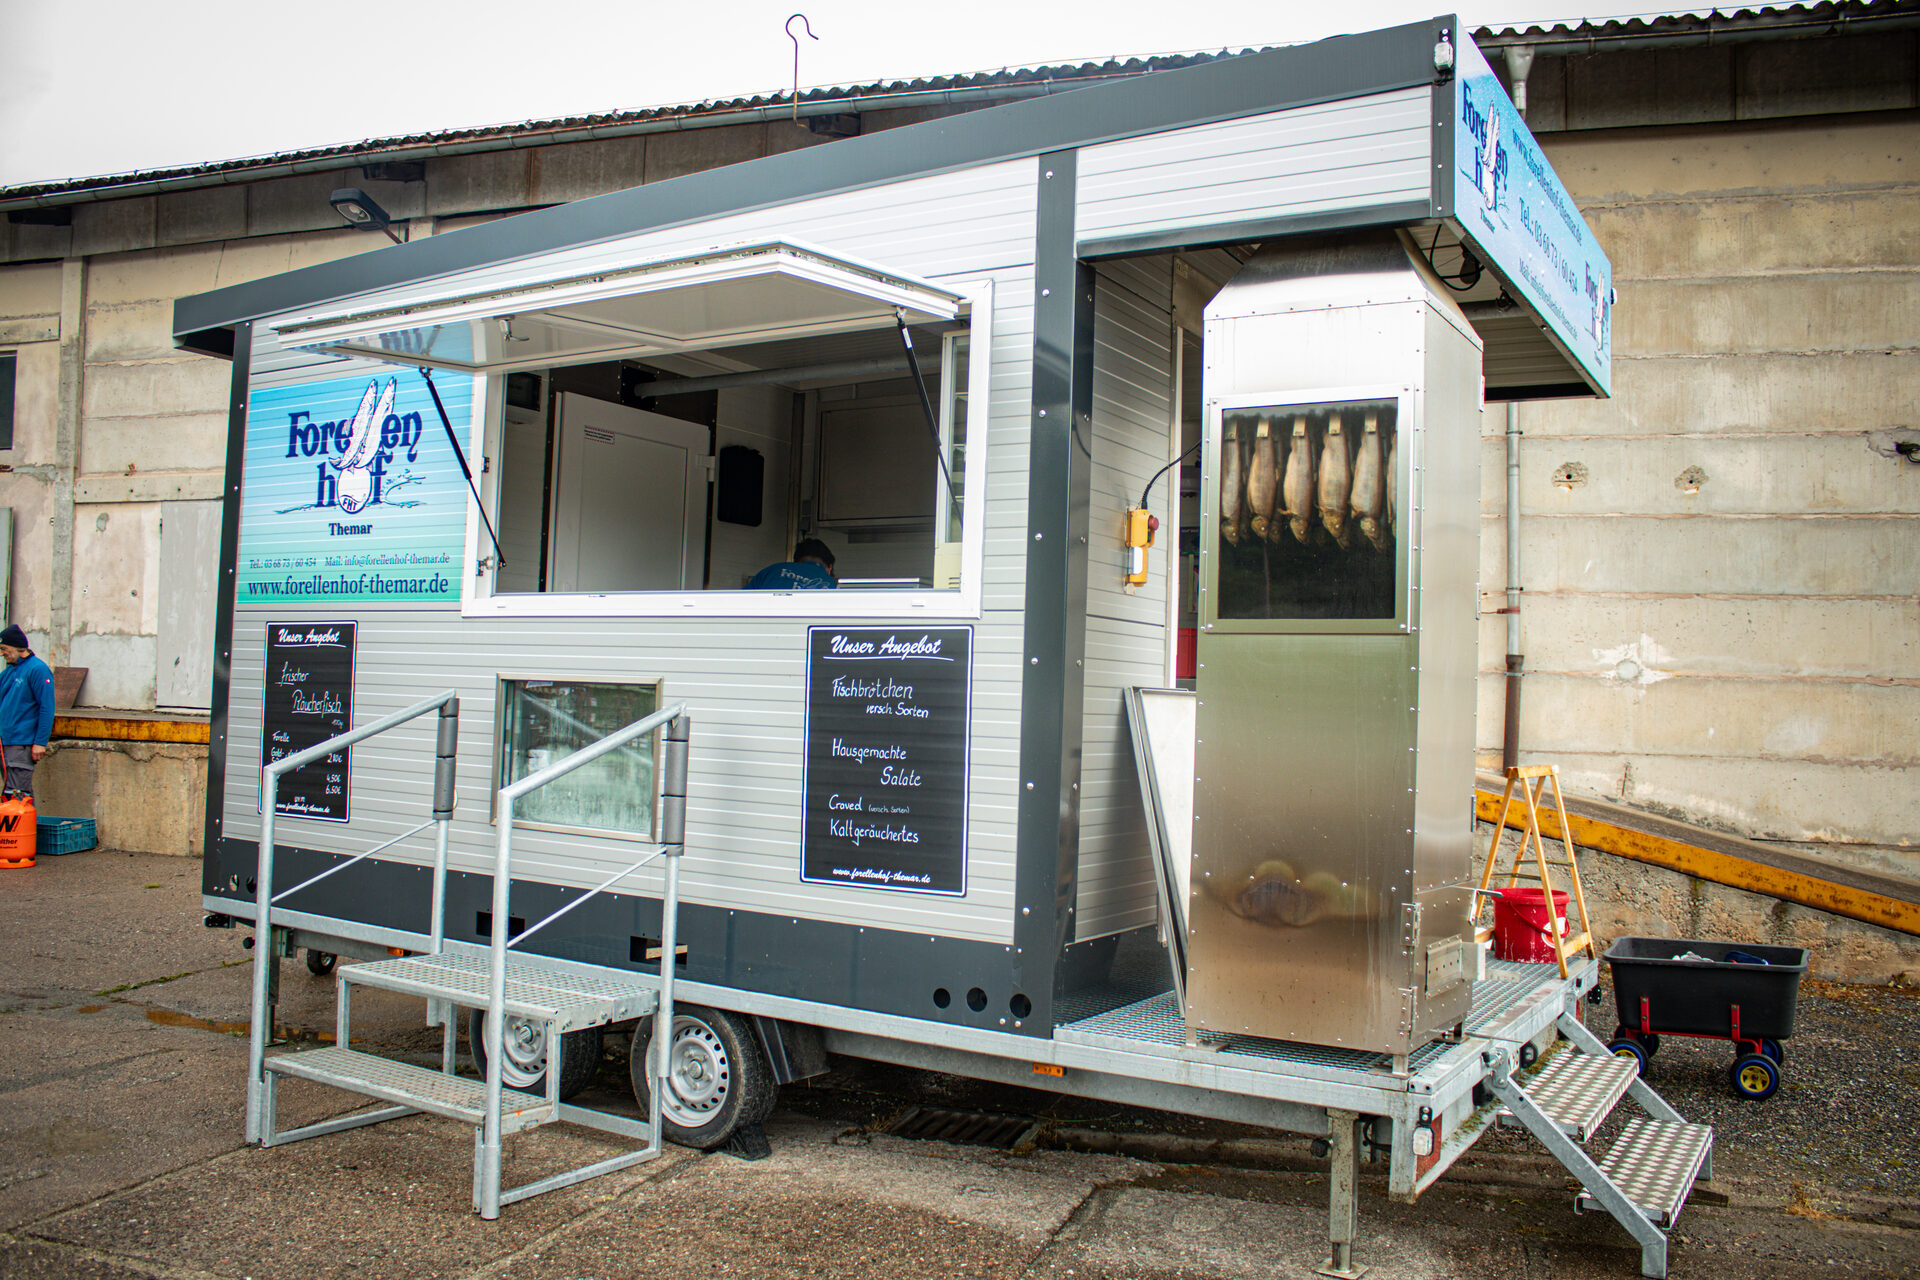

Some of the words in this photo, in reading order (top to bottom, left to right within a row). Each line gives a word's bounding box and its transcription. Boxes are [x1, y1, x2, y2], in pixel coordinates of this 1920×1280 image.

[328, 522, 373, 536] Themar
[248, 573, 449, 595] www.forellenhof-themar.de
[278, 628, 303, 643] Unser
[304, 628, 340, 648] Angebot
[831, 634, 875, 654] Unser
[878, 634, 942, 660] Angebot
[832, 675, 913, 699] Fischbrötchen
[895, 702, 929, 718] Sorten
[832, 738, 907, 764] Hausgemachte
[880, 765, 922, 787] Salate
[830, 818, 919, 847] Kaltgeräuchertes
